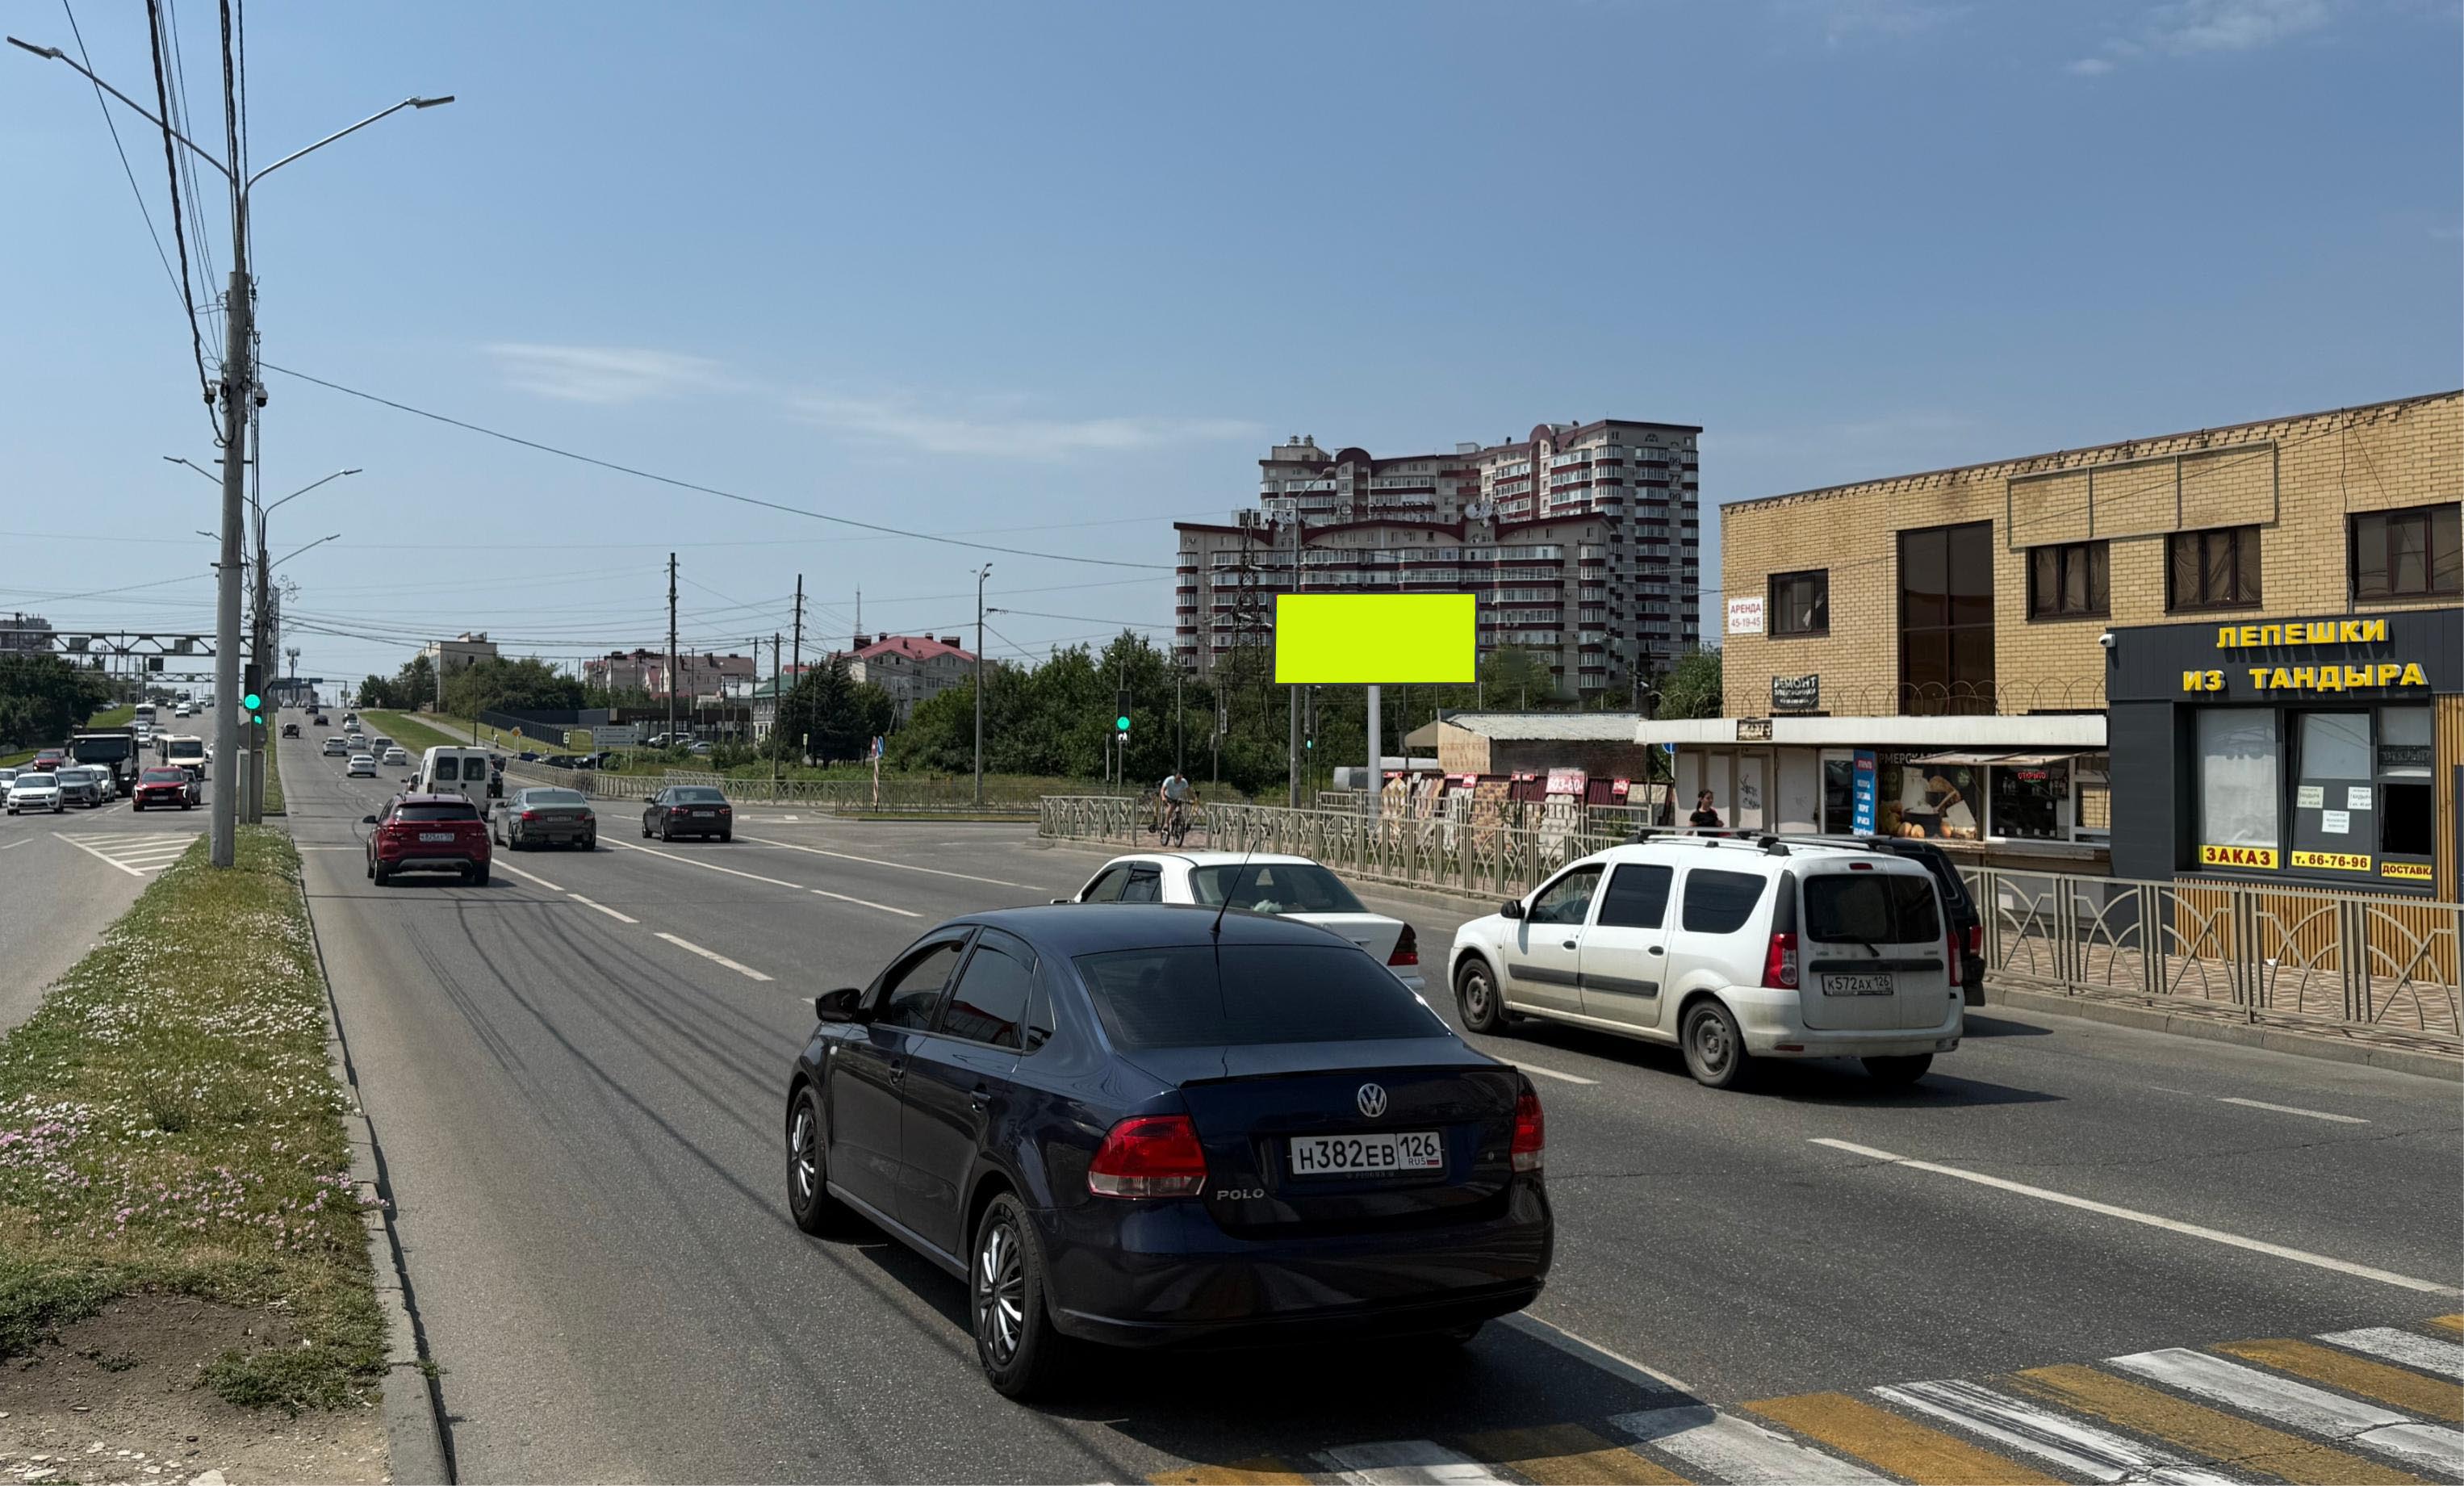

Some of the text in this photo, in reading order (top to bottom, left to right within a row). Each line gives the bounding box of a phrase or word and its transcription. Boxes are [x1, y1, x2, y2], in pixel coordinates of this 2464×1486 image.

[1730, 604, 1761, 615] АРЕНДА
[1731, 617, 1761, 628] 45-19-45
[2216, 619, 2387, 648] ЛЕПЕШКИ
[1774, 676, 1817, 689] РЕМОНТ
[2183, 663, 2426, 693] ИЗ ТАНДЫРА
[2206, 847, 2271, 865] ЗАКАЗ
[2308, 854, 2368, 869] 66-76-96
[1827, 976, 1890, 990] К572АХ 126
[1299, 1135, 1437, 1170] Н382ЕВ 126
[1408, 1157, 1427, 1166] RUS
[1216, 1188, 1265, 1201] POLO
